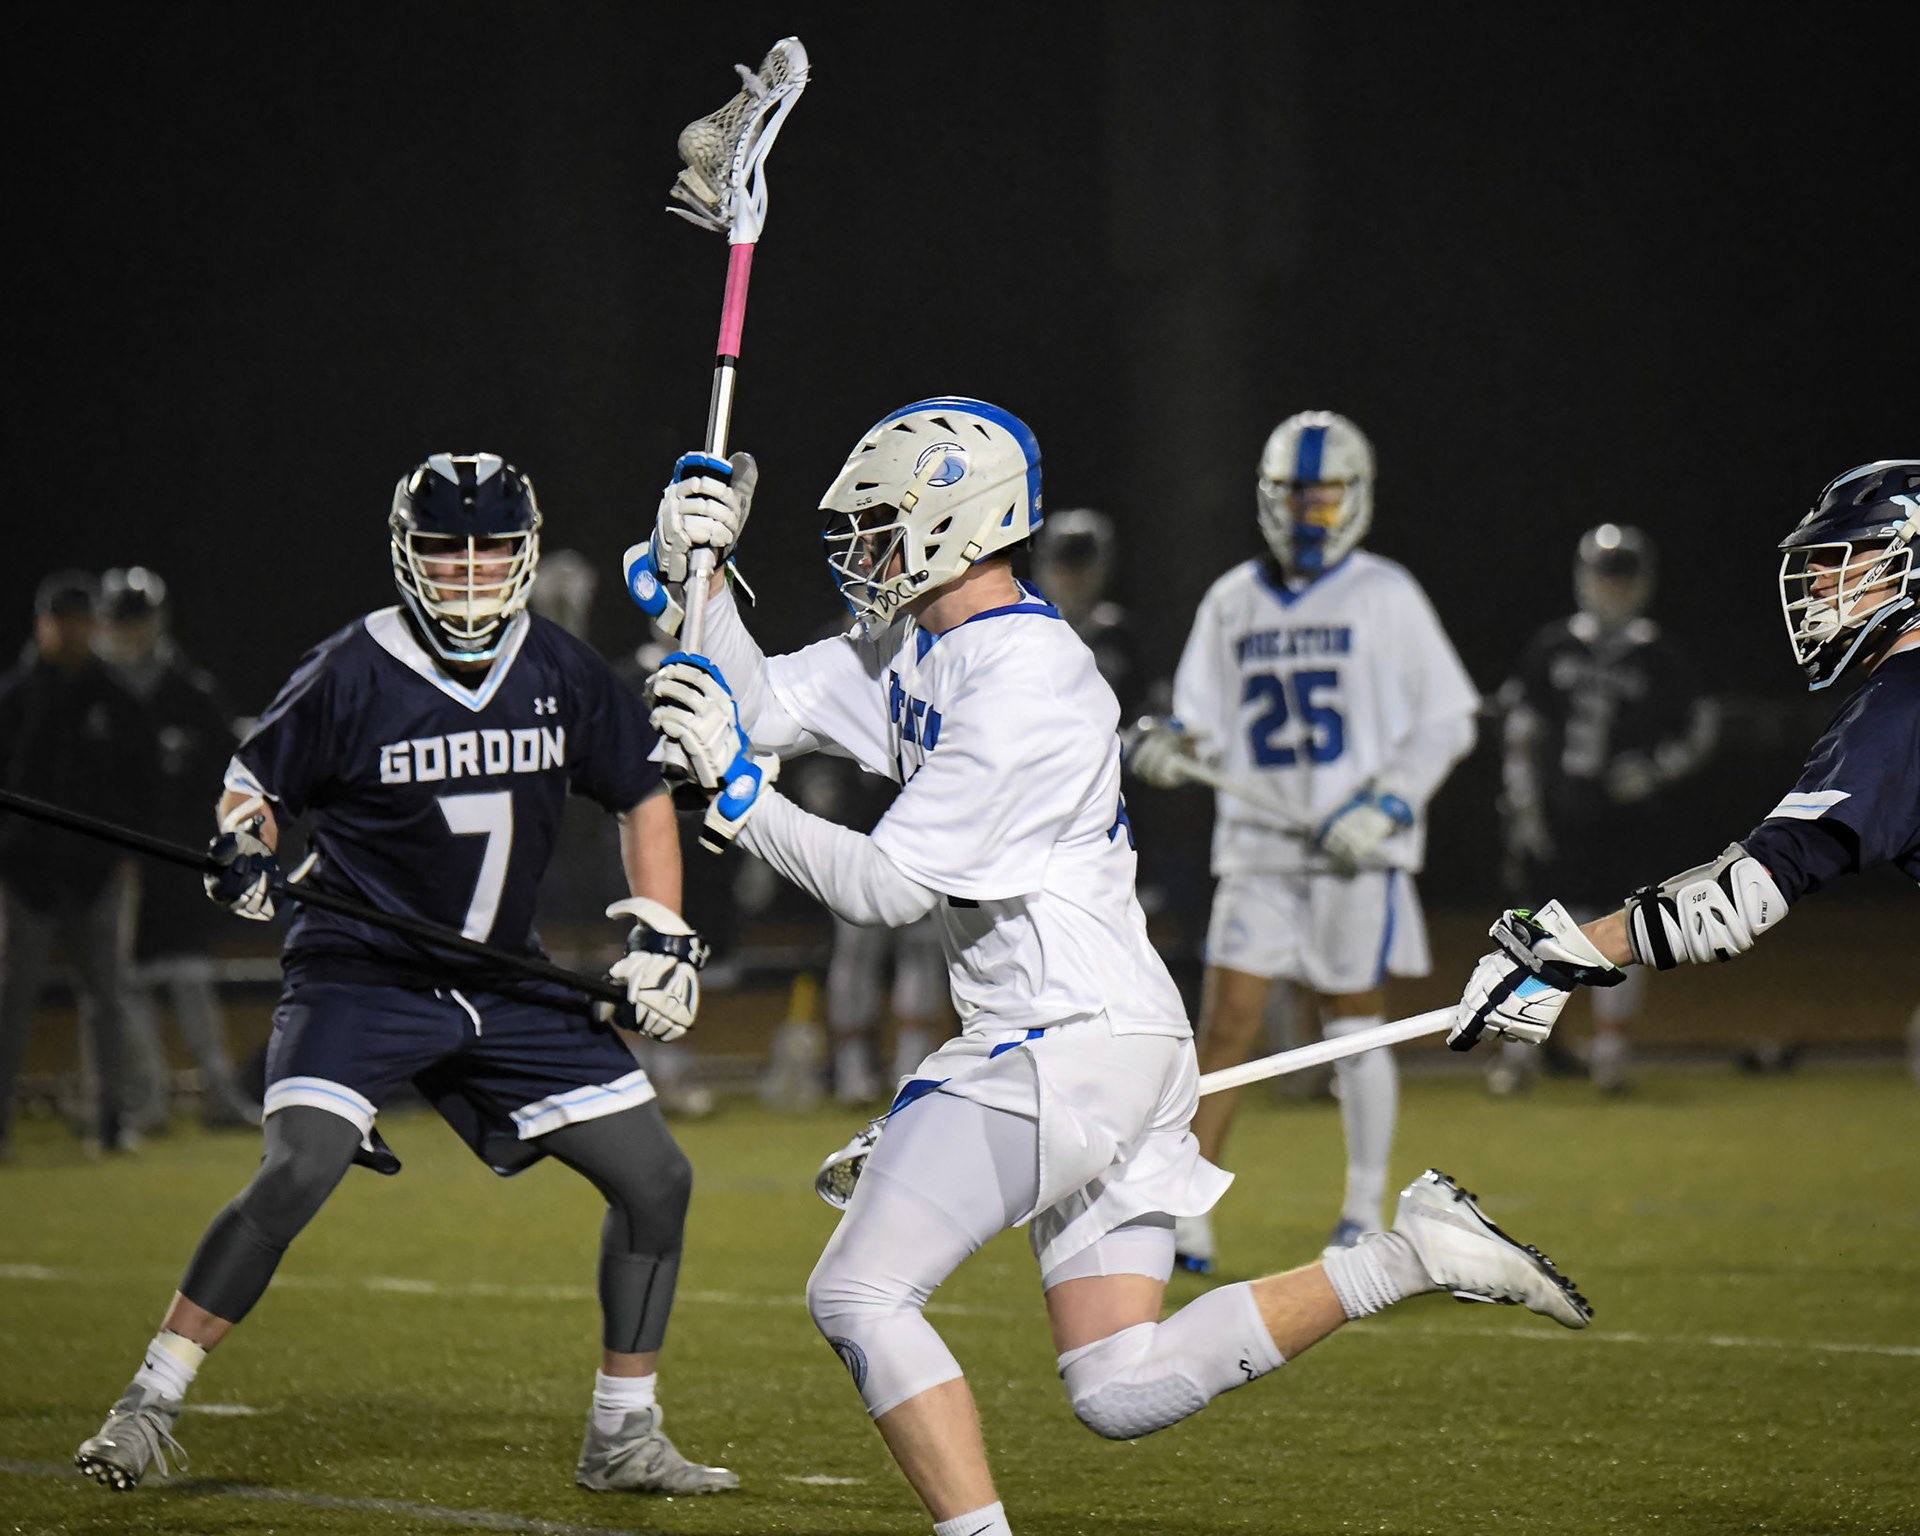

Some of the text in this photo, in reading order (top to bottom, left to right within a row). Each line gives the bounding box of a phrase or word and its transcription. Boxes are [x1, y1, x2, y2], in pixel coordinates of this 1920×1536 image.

[876, 582, 913, 614] DOC
[379, 725, 566, 785] GORDON
[1241, 670, 1344, 767] 25
[436, 789, 514, 944] 7
